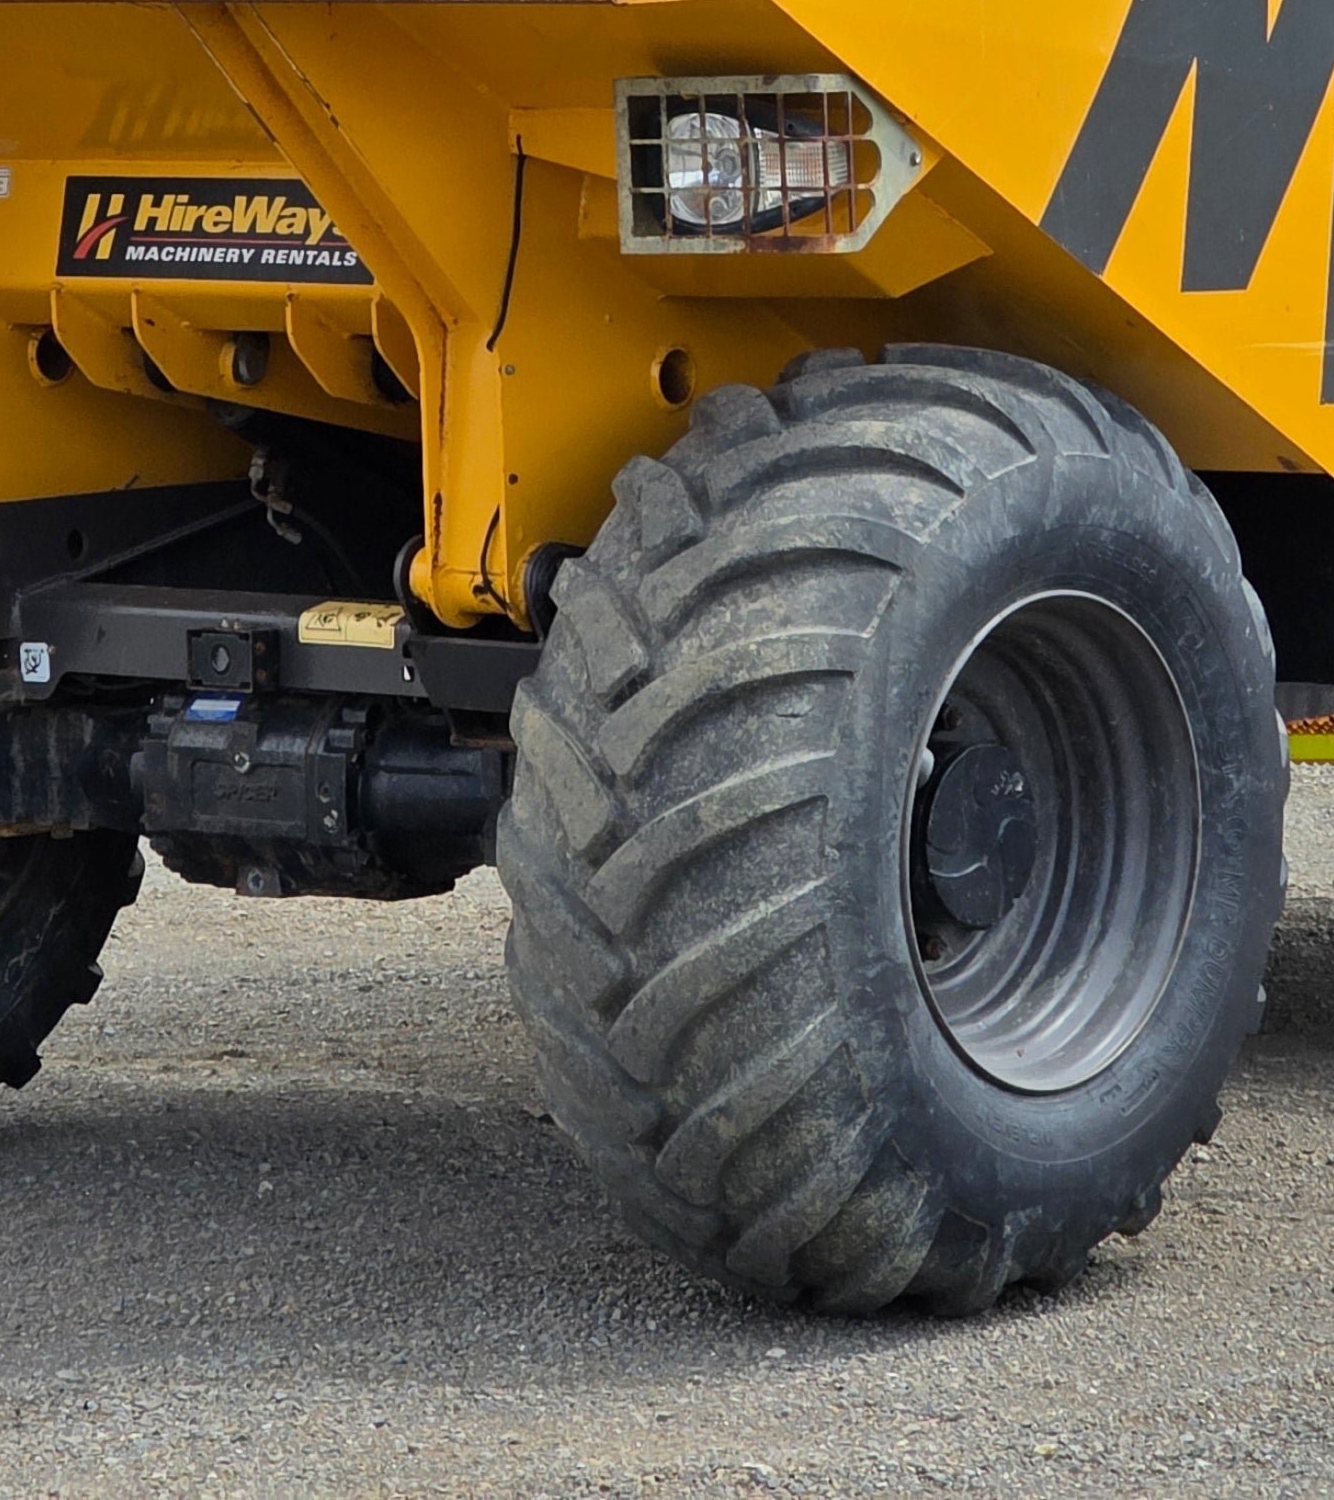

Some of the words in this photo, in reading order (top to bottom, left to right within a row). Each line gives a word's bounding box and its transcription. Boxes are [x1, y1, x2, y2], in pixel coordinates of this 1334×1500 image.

[133, 193, 345, 245] HireWay
[125, 246, 255, 264] MACHINERY
[260, 249, 358, 267] RENTALS
